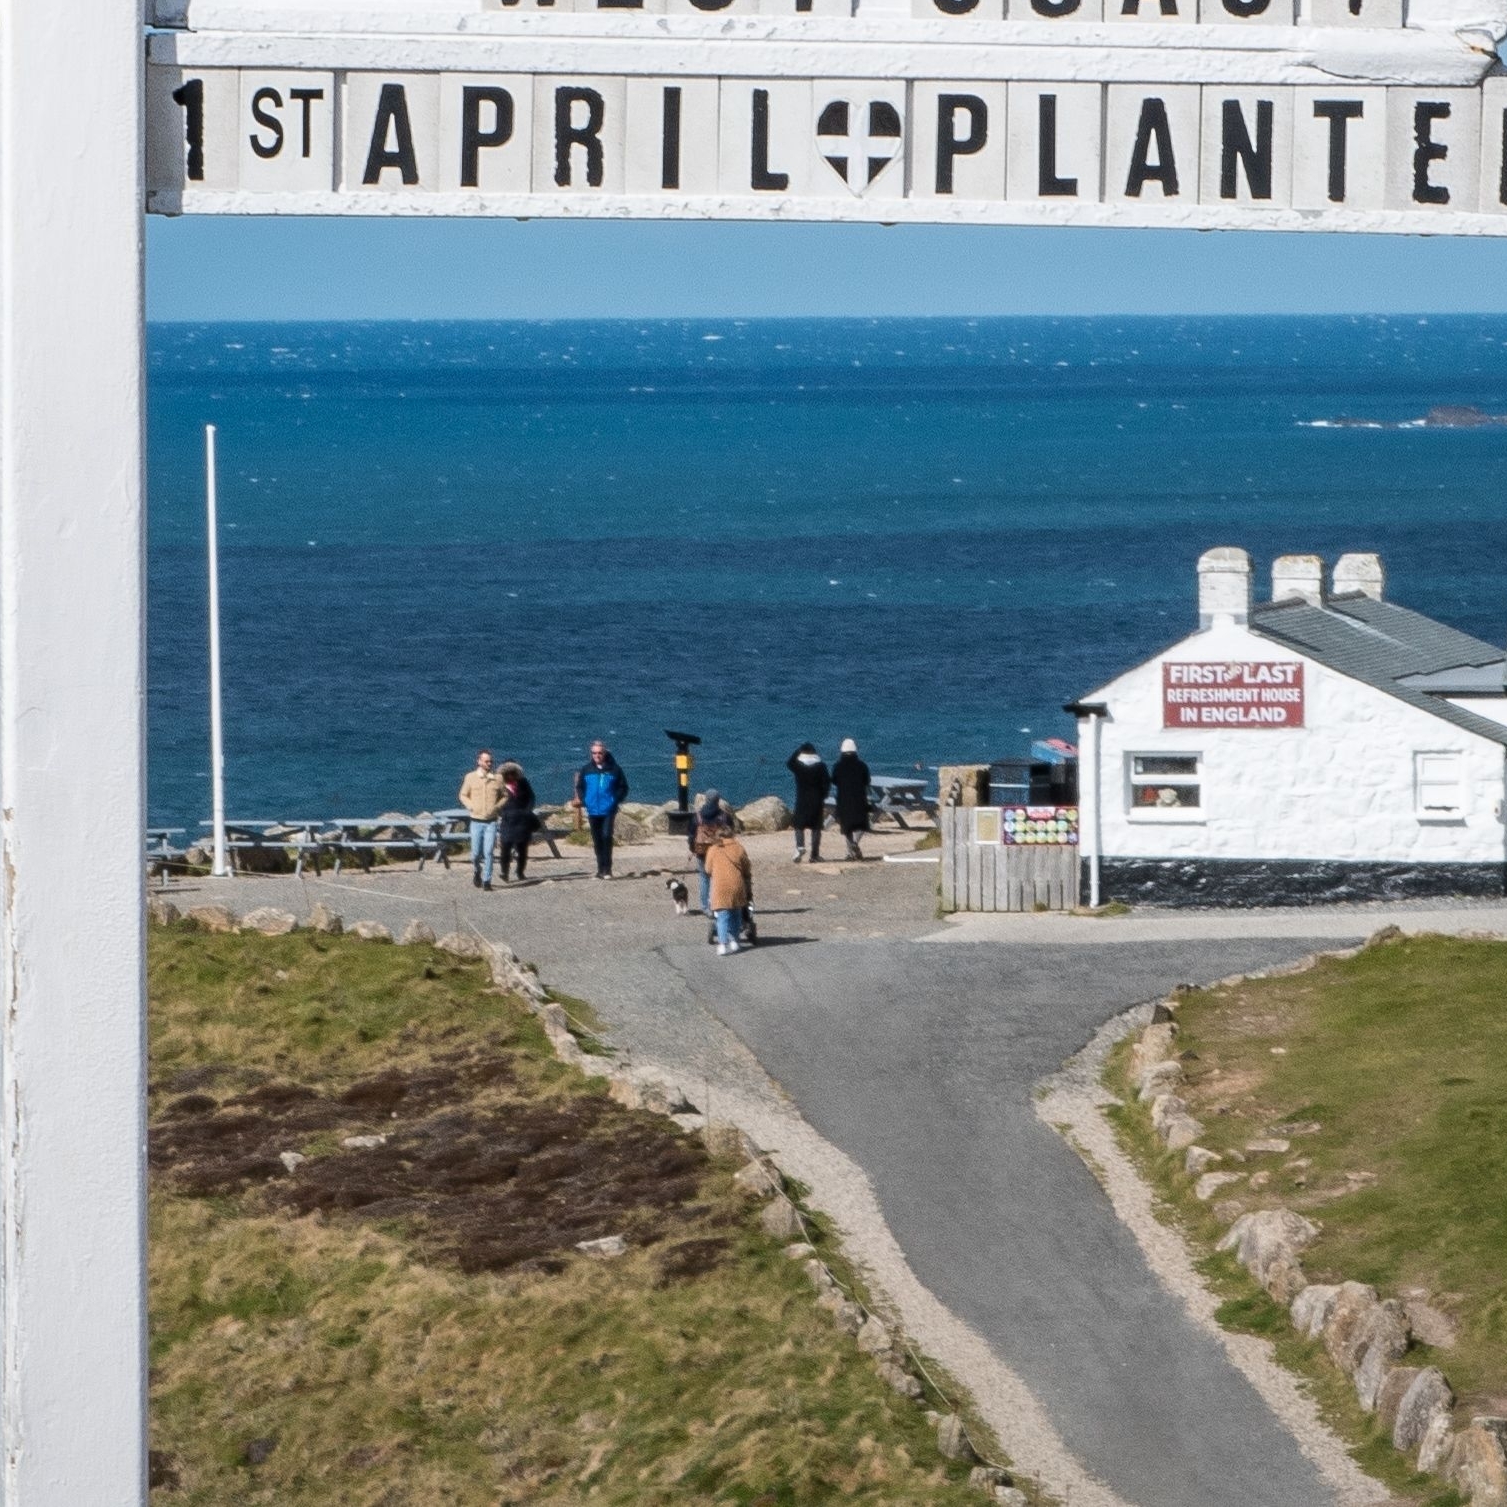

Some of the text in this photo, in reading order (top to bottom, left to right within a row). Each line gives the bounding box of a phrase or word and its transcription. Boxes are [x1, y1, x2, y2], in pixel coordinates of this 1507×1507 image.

[363, 84, 788, 190] APRIL
[1170, 665, 1226, 684] FIRST
[1242, 665, 1295, 684] LAST
[1167, 688, 1300, 702] REFRESHMENT HOUSE
[1180, 707, 1287, 722] IN ENGLAND
